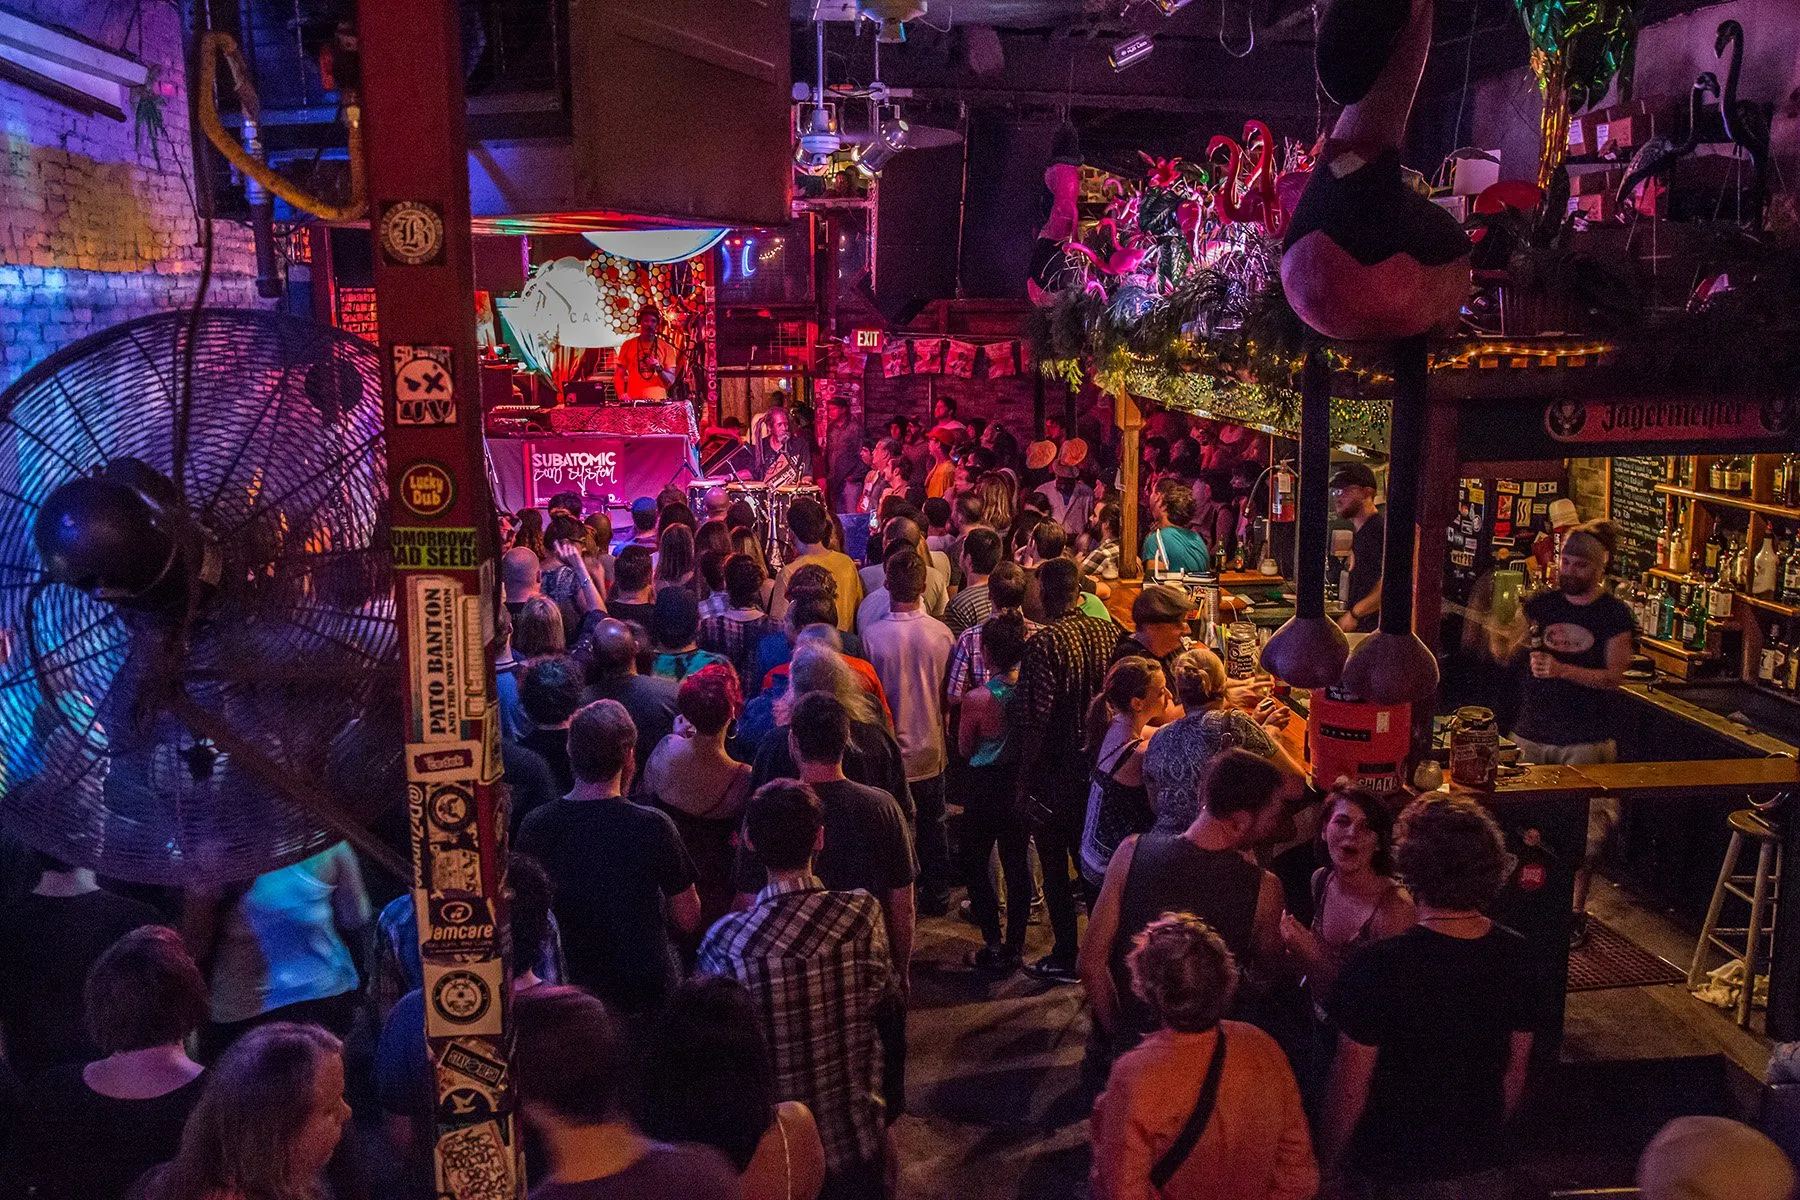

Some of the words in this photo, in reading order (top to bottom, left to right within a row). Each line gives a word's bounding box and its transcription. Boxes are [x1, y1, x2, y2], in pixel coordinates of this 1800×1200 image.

[857, 330, 880, 347] EXIT
[532, 452, 616, 467] SUBATOMIC
[409, 472, 444, 493] Lucky
[413, 489, 441, 506] Dub
[424, 587, 445, 675] BANTON
[443, 587, 454, 659] GENERATION
[445, 664, 455, 687] NOW
[429, 682, 447, 735] PATO
[446, 689, 456, 710] THE
[447, 712, 457, 735] AND
